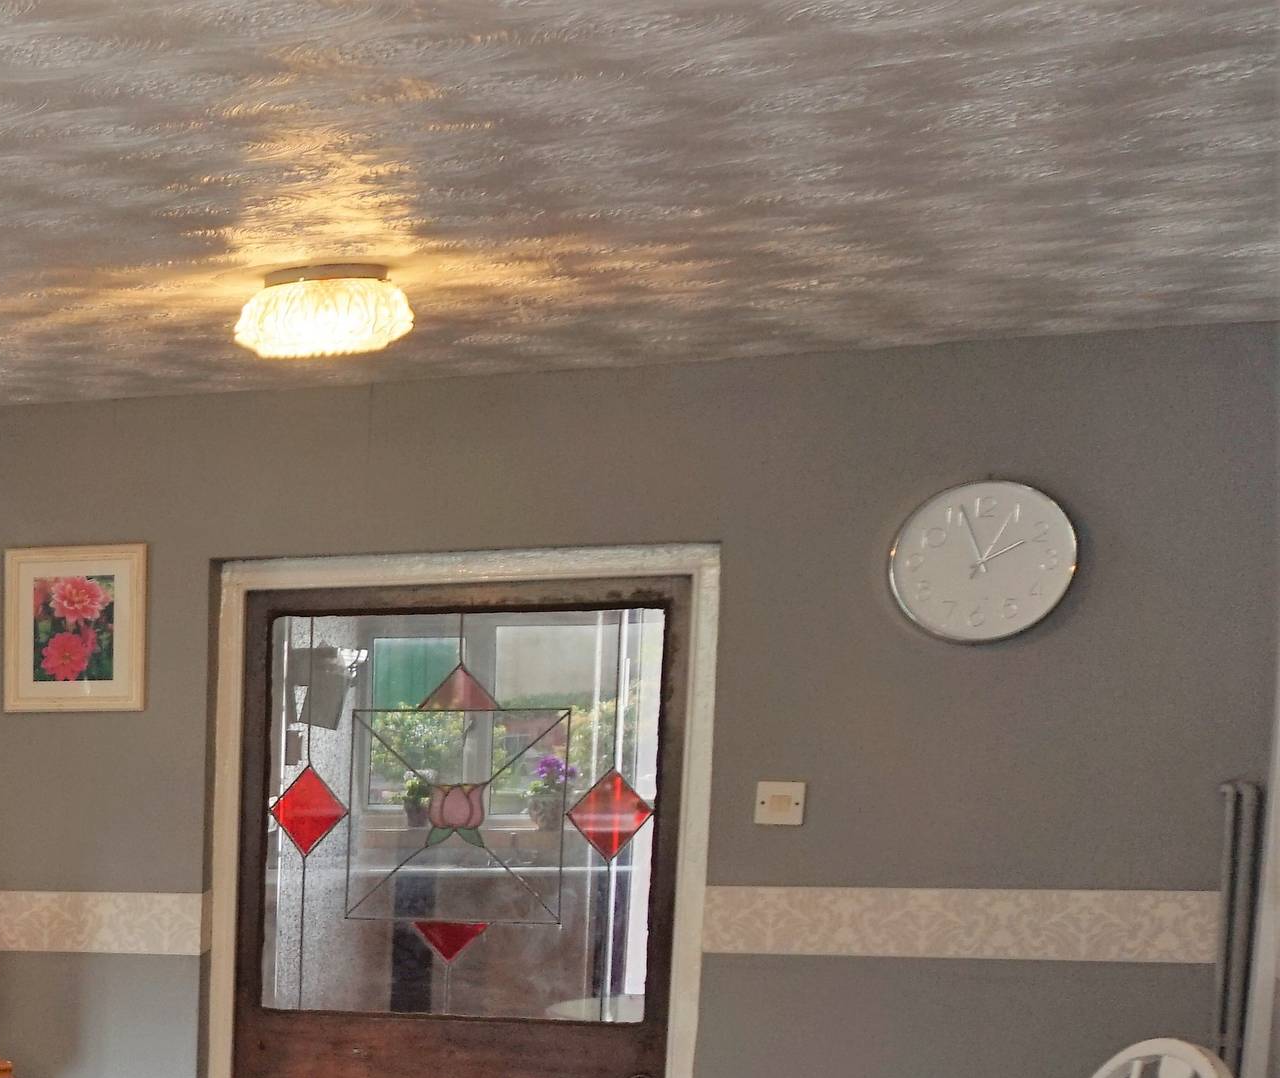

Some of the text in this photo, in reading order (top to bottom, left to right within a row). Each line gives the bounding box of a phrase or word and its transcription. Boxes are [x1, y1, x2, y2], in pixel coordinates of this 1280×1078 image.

[975, 496, 997, 518] 12
[920, 527, 946, 548] 10
[1031, 521, 1049, 542] 2
[905, 553, 924, 572] 9
[1040, 548, 1058, 570] 3
[941, 600, 957, 620] 7
[967, 605, 985, 627] 6
[1002, 598, 1019, 620] 5
